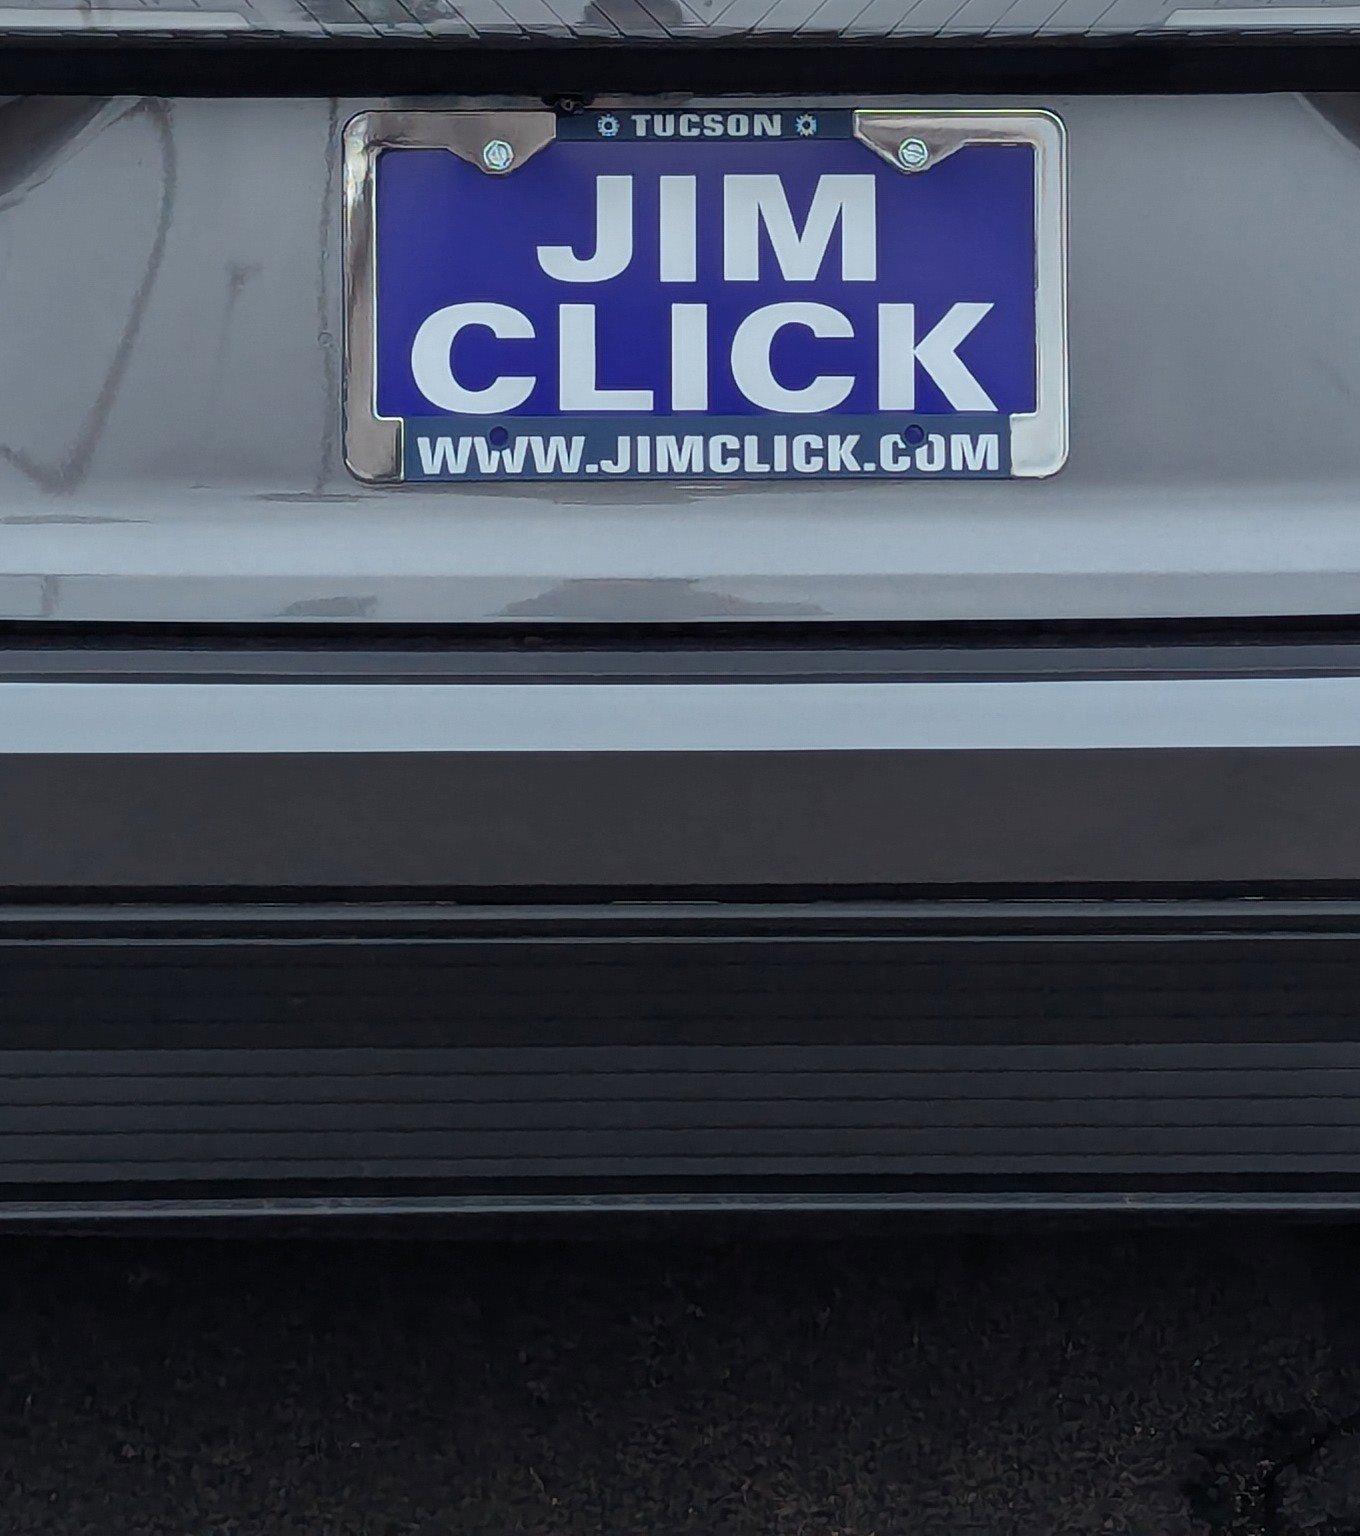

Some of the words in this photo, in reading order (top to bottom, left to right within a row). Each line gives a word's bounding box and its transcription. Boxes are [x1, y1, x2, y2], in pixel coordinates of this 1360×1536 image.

[631, 113, 782, 138] TUCSON
[536, 174, 877, 283] JIM
[411, 302, 999, 414] CLICK
[416, 434, 1000, 475] WWW.JIMCLICK.COM
